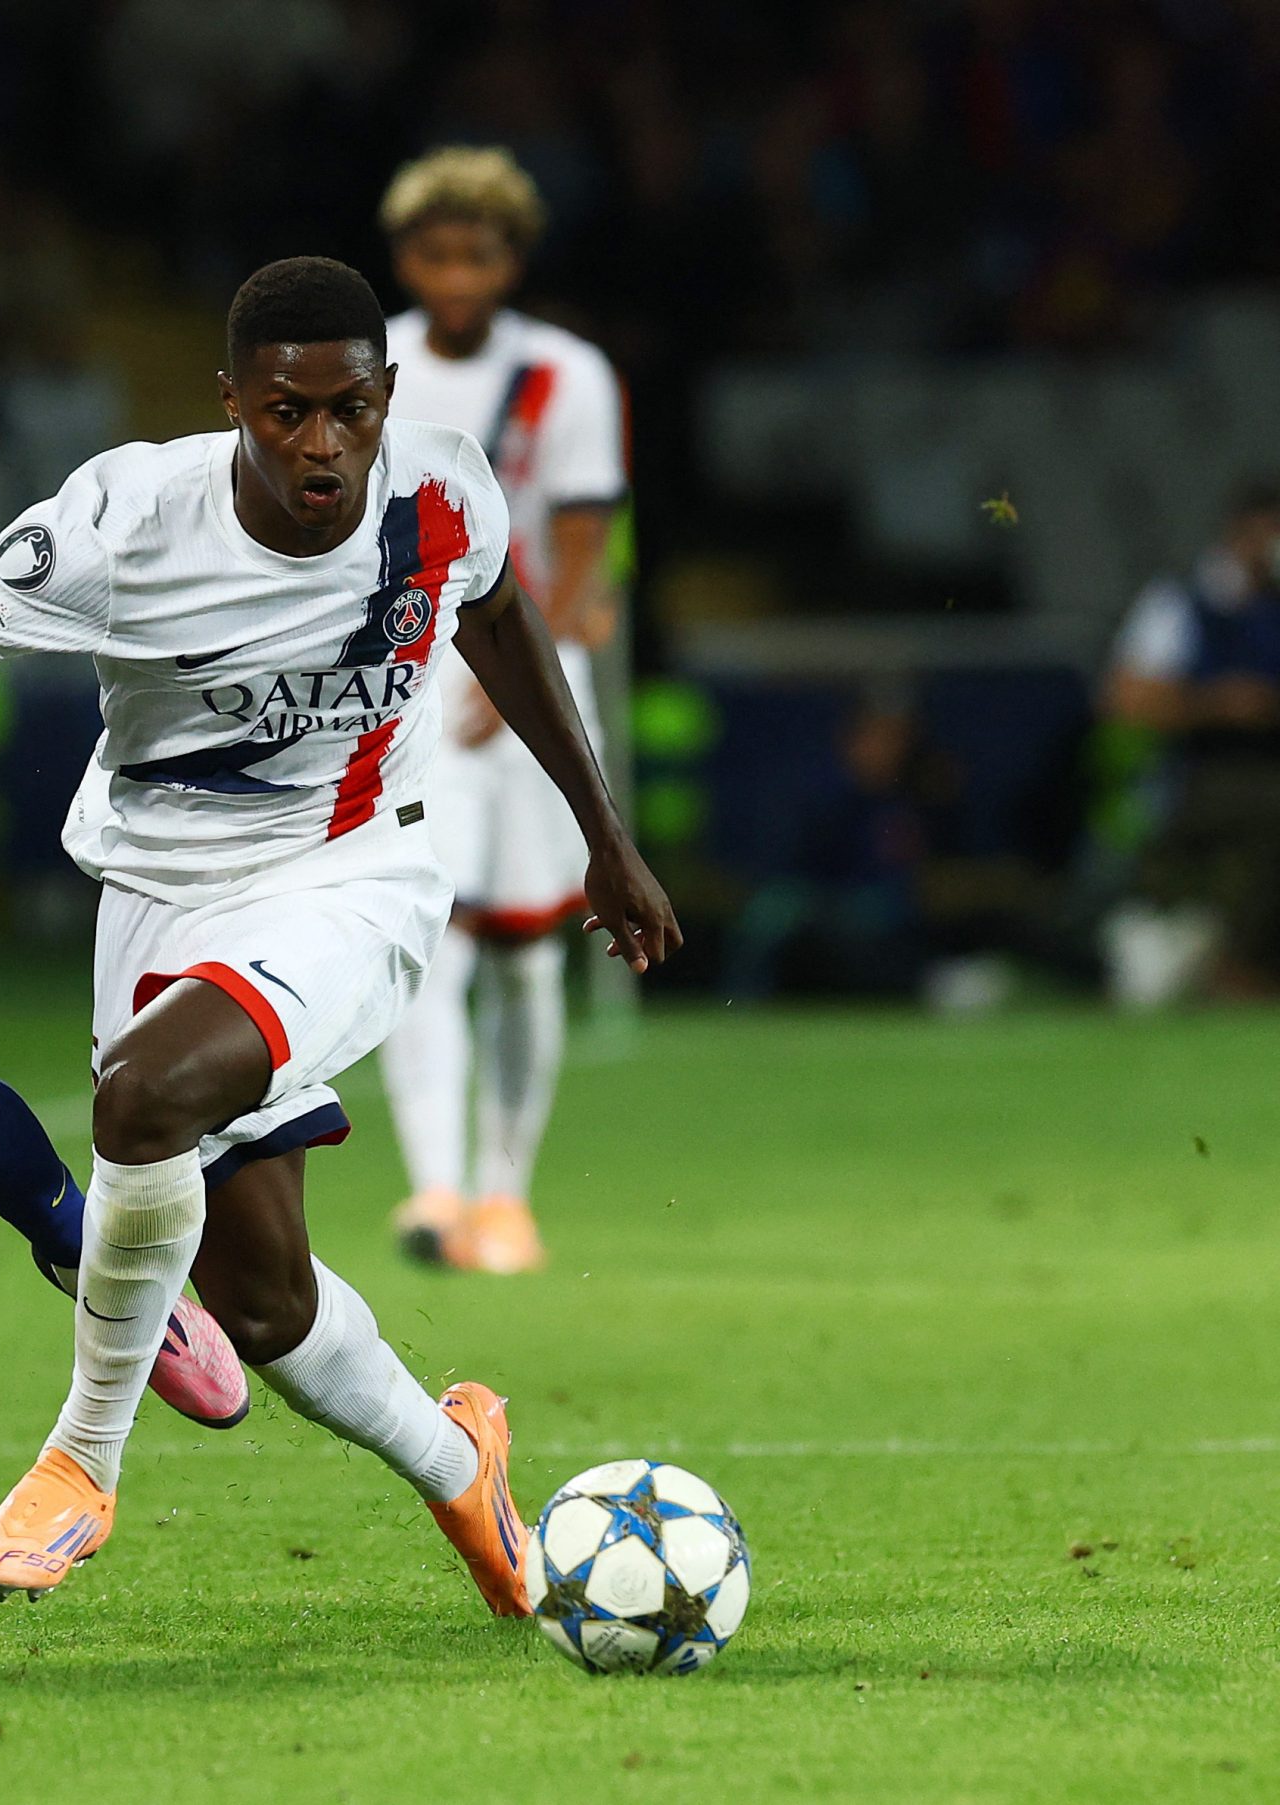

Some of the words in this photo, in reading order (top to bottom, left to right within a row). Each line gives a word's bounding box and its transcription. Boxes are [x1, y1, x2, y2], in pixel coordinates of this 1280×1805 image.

[394, 592, 423, 610] PARIS
[202, 664, 414, 722] QATAR
[248, 702, 408, 739] AIRWAY
